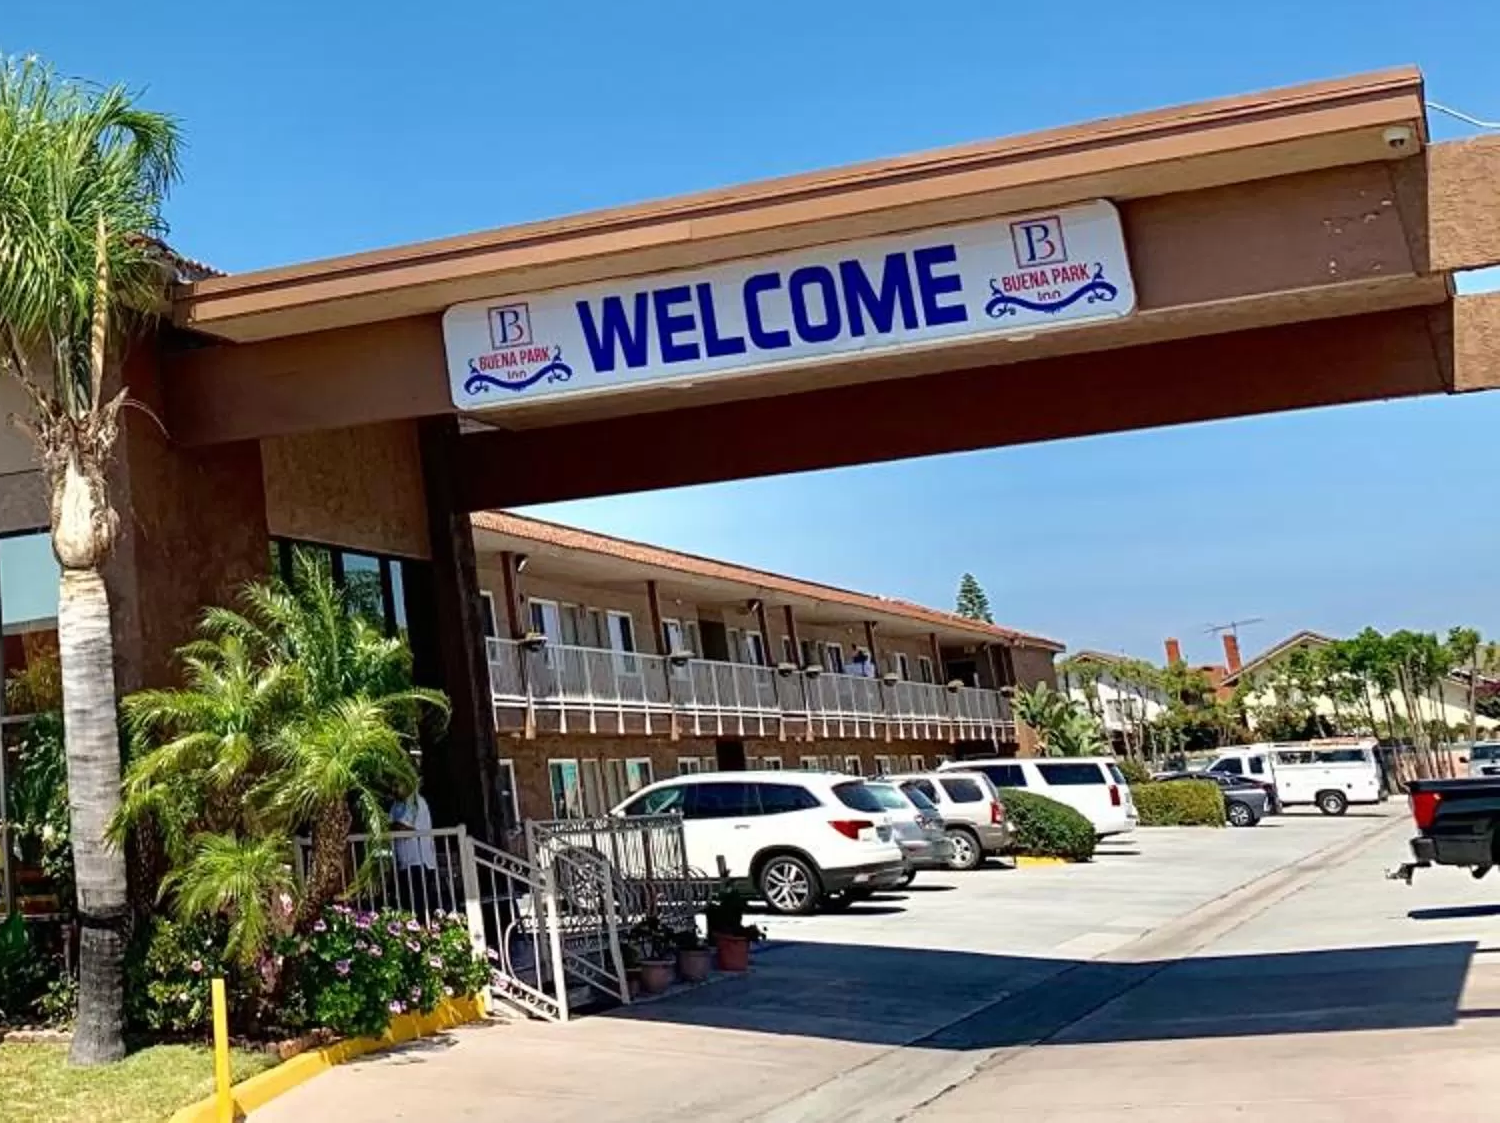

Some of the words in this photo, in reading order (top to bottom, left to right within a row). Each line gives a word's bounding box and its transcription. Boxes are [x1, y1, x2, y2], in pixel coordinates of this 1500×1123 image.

[1001, 270, 1051, 293] BUENA
[1051, 263, 1091, 286] PARK
[576, 244, 969, 373] WELCOME
[478, 350, 518, 372] BUENA
[519, 346, 551, 365] PARK
